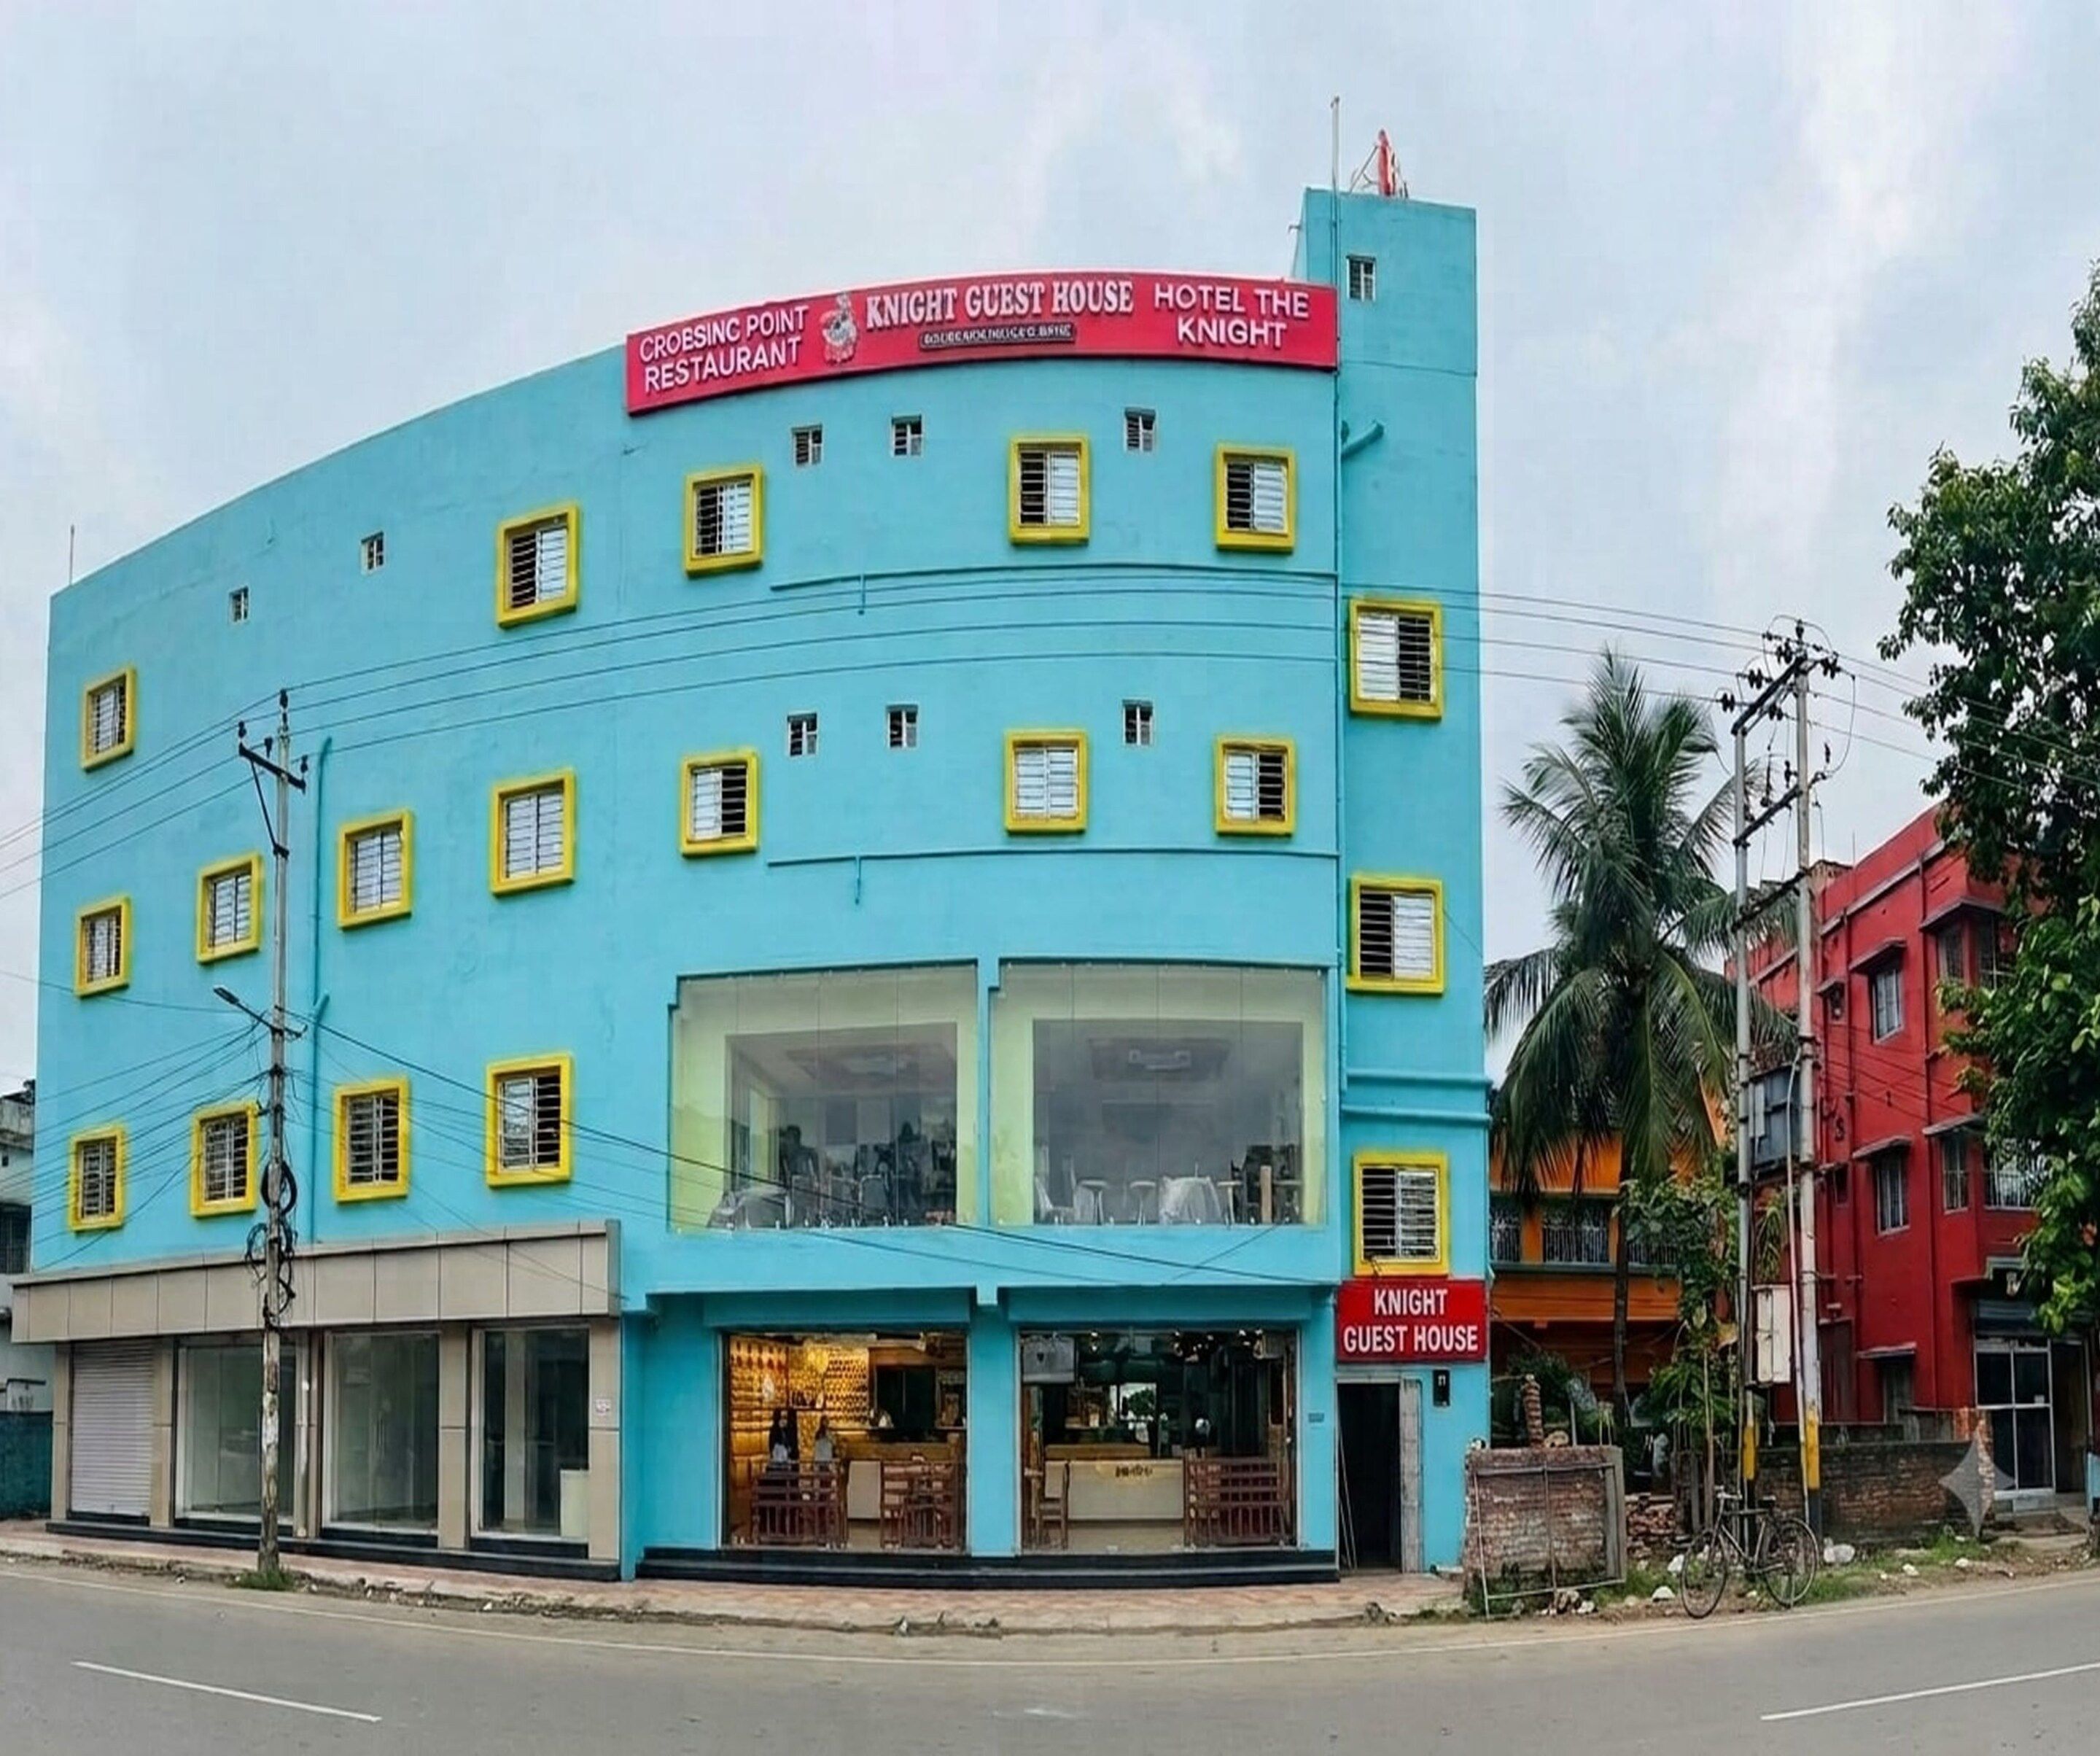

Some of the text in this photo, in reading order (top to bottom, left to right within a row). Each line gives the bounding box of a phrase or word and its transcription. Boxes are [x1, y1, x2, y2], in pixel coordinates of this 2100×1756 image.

[866, 281, 1134, 329] KNIGHT GUEST HOUSE
[1154, 283, 1310, 318] HOTEL THE
[746, 306, 808, 338] POINT
[1178, 318, 1287, 347] KNIGHT
[645, 337, 801, 392] RESTAURANT
[1374, 1289, 1448, 1316] KNIGHT
[1343, 1325, 1479, 1353] GUEST HOUSE
